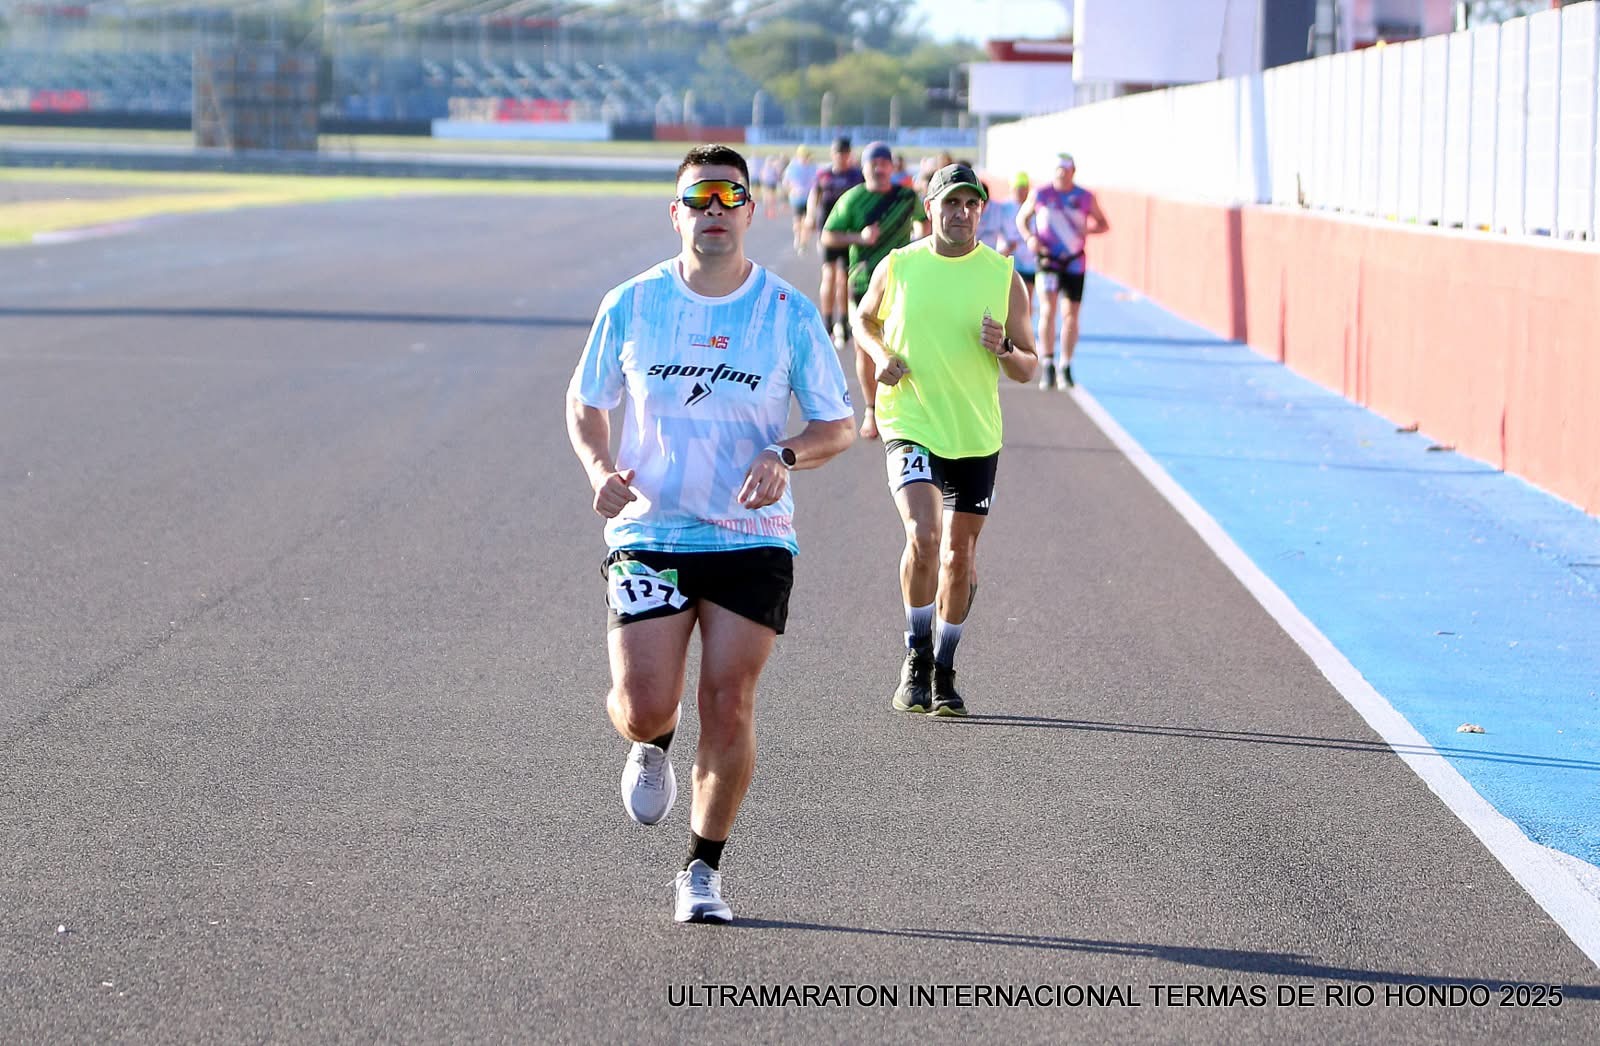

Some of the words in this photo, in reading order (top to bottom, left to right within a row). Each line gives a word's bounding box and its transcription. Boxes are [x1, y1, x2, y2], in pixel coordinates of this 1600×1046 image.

[647, 363, 762, 392] sporting
[900, 455, 926, 476] 24
[620, 579, 675, 603] 127
